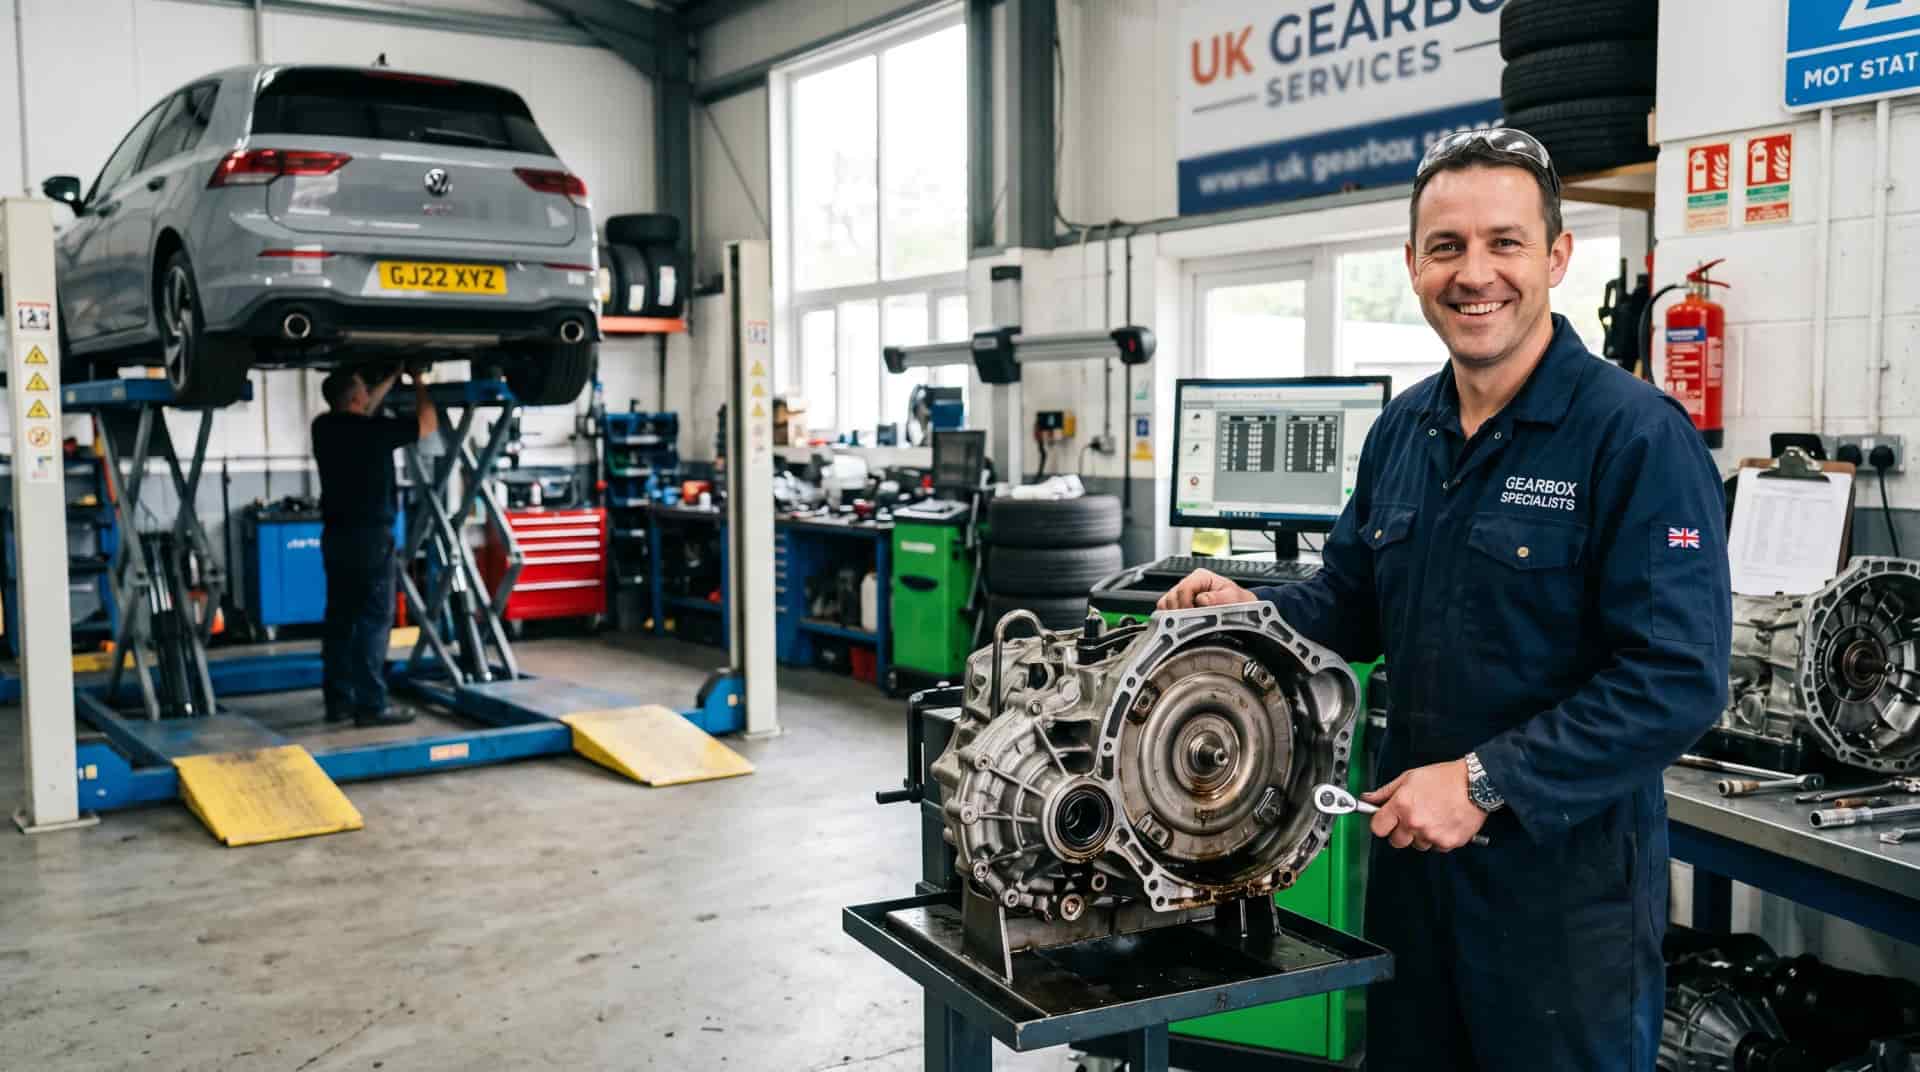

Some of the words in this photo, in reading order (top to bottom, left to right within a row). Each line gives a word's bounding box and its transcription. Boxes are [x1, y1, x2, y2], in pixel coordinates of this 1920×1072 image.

[1191, 25, 1254, 86] UK
[1269, 0, 1504, 65] GEARB
[1265, 39, 1441, 109] SERVICES
[1804, 62, 1854, 90] MOT
[1312, 137, 1415, 184] gearbox
[389, 265, 448, 288] GJ22
[455, 268, 497, 290] XYZ
[1505, 475, 1577, 497] GEARBOX
[1500, 491, 1576, 511] SPECIALISTS
